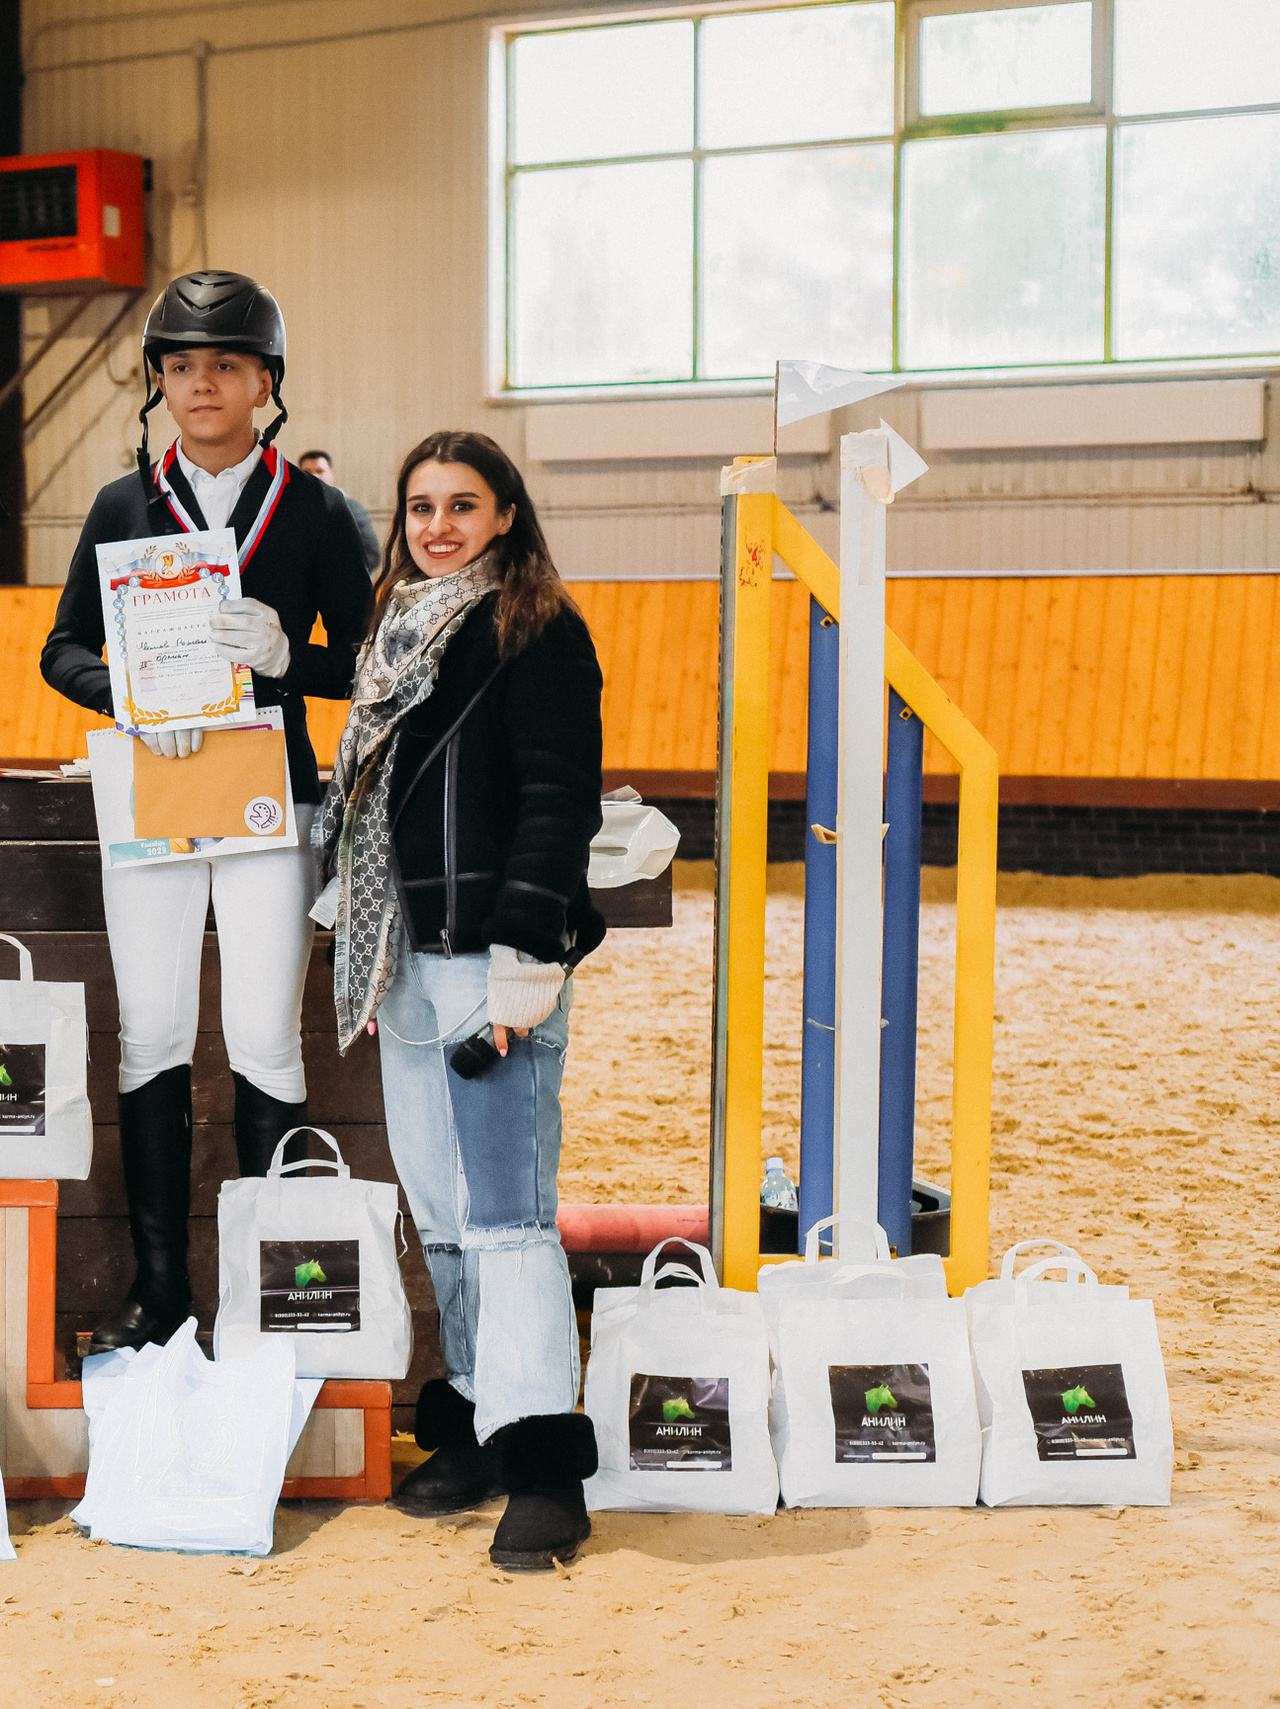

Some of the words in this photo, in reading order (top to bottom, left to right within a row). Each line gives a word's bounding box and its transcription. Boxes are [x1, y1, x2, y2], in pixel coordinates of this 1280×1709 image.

[132, 587, 211, 607] ГРАМОТА
[138, 623, 207, 636] НАГРАЖДАЕТС
[146, 846, 167, 856] 2023
[287, 1291, 333, 1301] АНИЛИН
[861, 1416, 907, 1427] АНИЛИН
[1061, 1414, 1107, 1424] АНИЛИН
[655, 1426, 702, 1436] АНИЛИН
